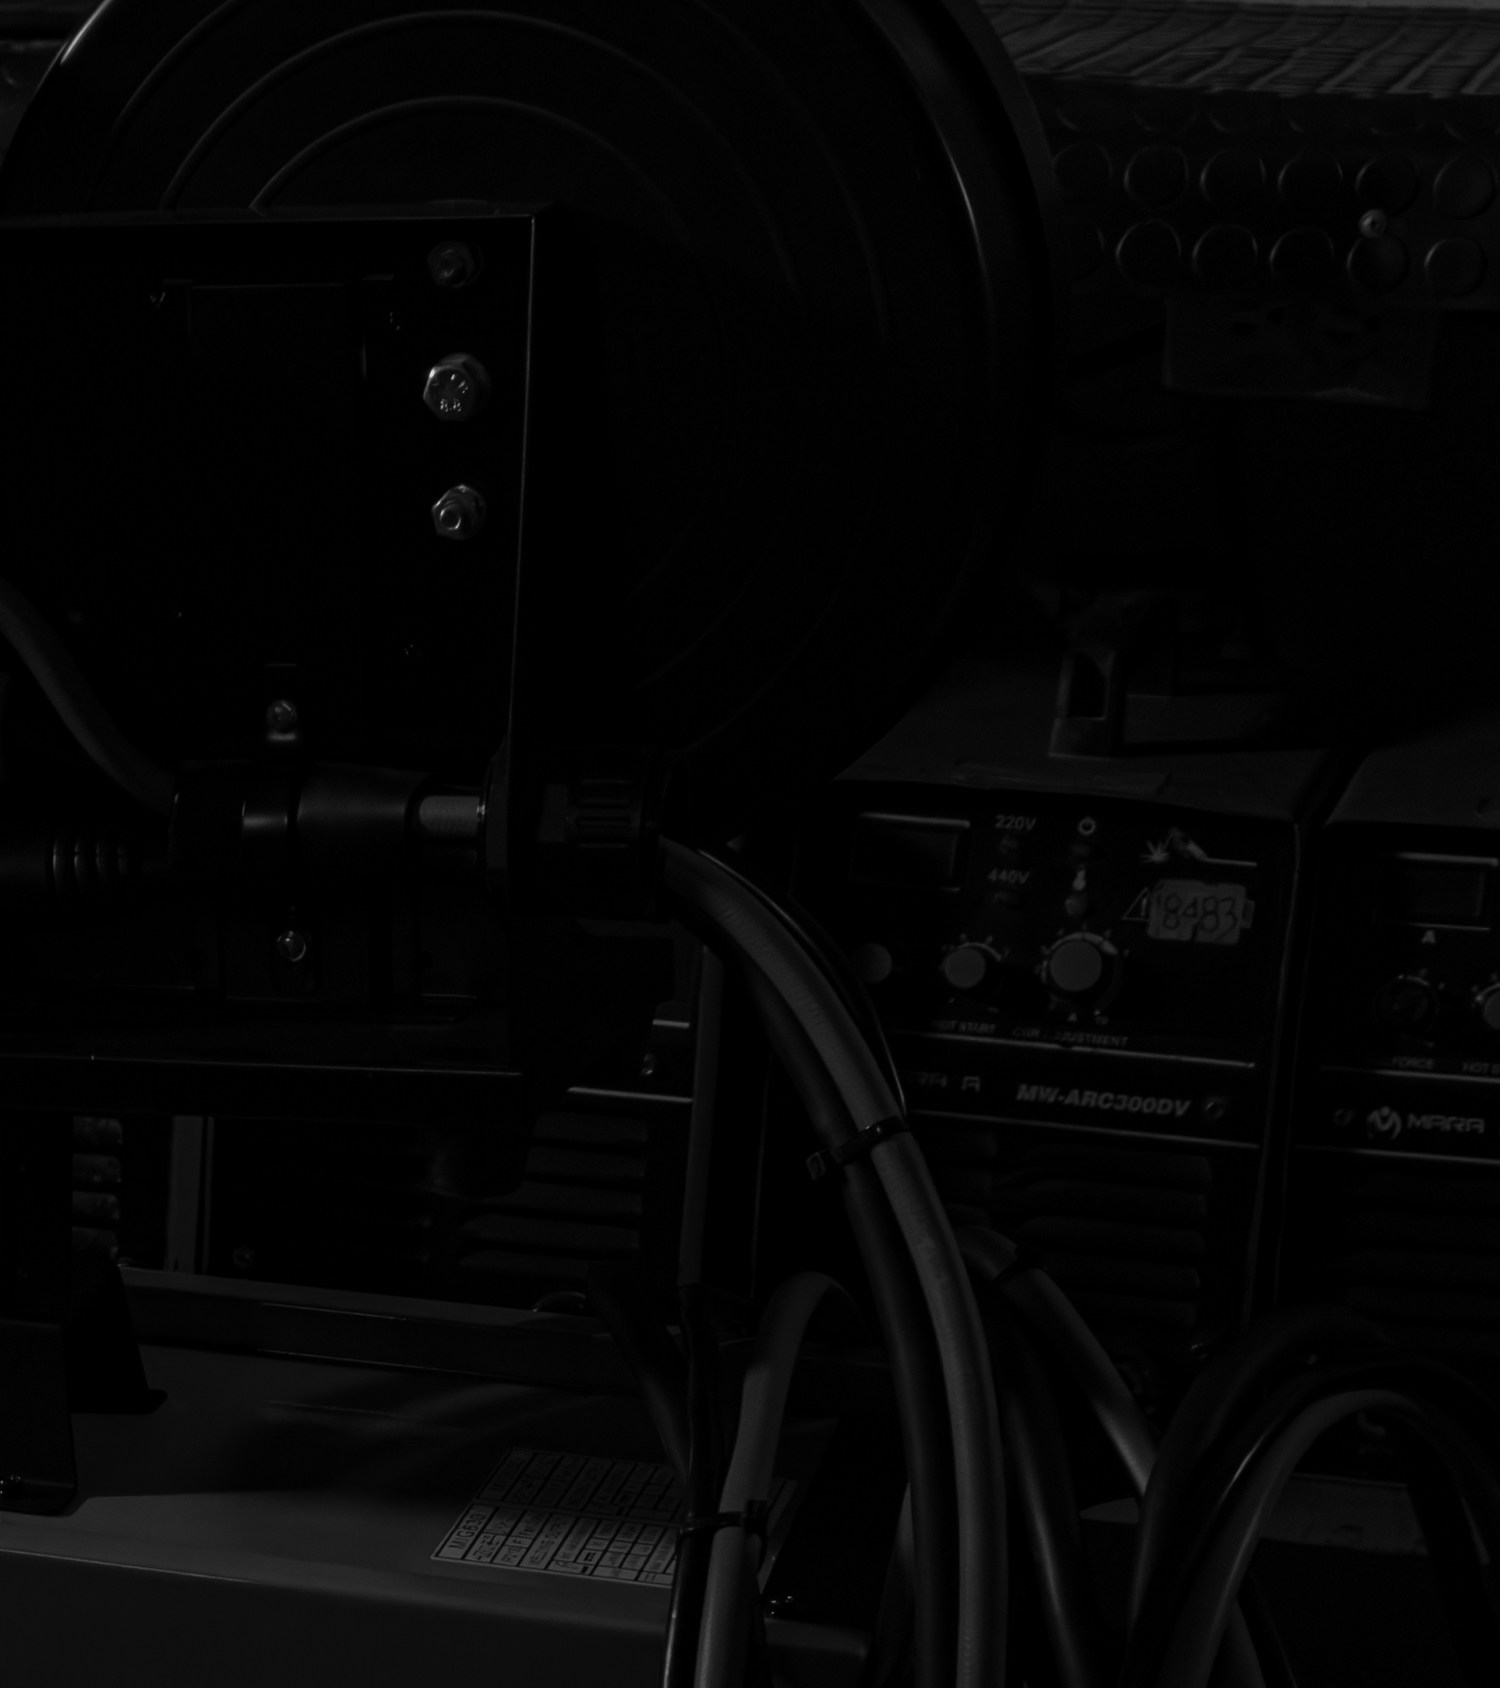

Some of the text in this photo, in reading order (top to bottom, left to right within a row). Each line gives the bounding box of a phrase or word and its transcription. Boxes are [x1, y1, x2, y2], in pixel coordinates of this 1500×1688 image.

[994, 814, 1037, 831] 220V
[987, 867, 1030, 885] 440V
[1015, 1083, 1192, 1118] MW-ARC300DV
